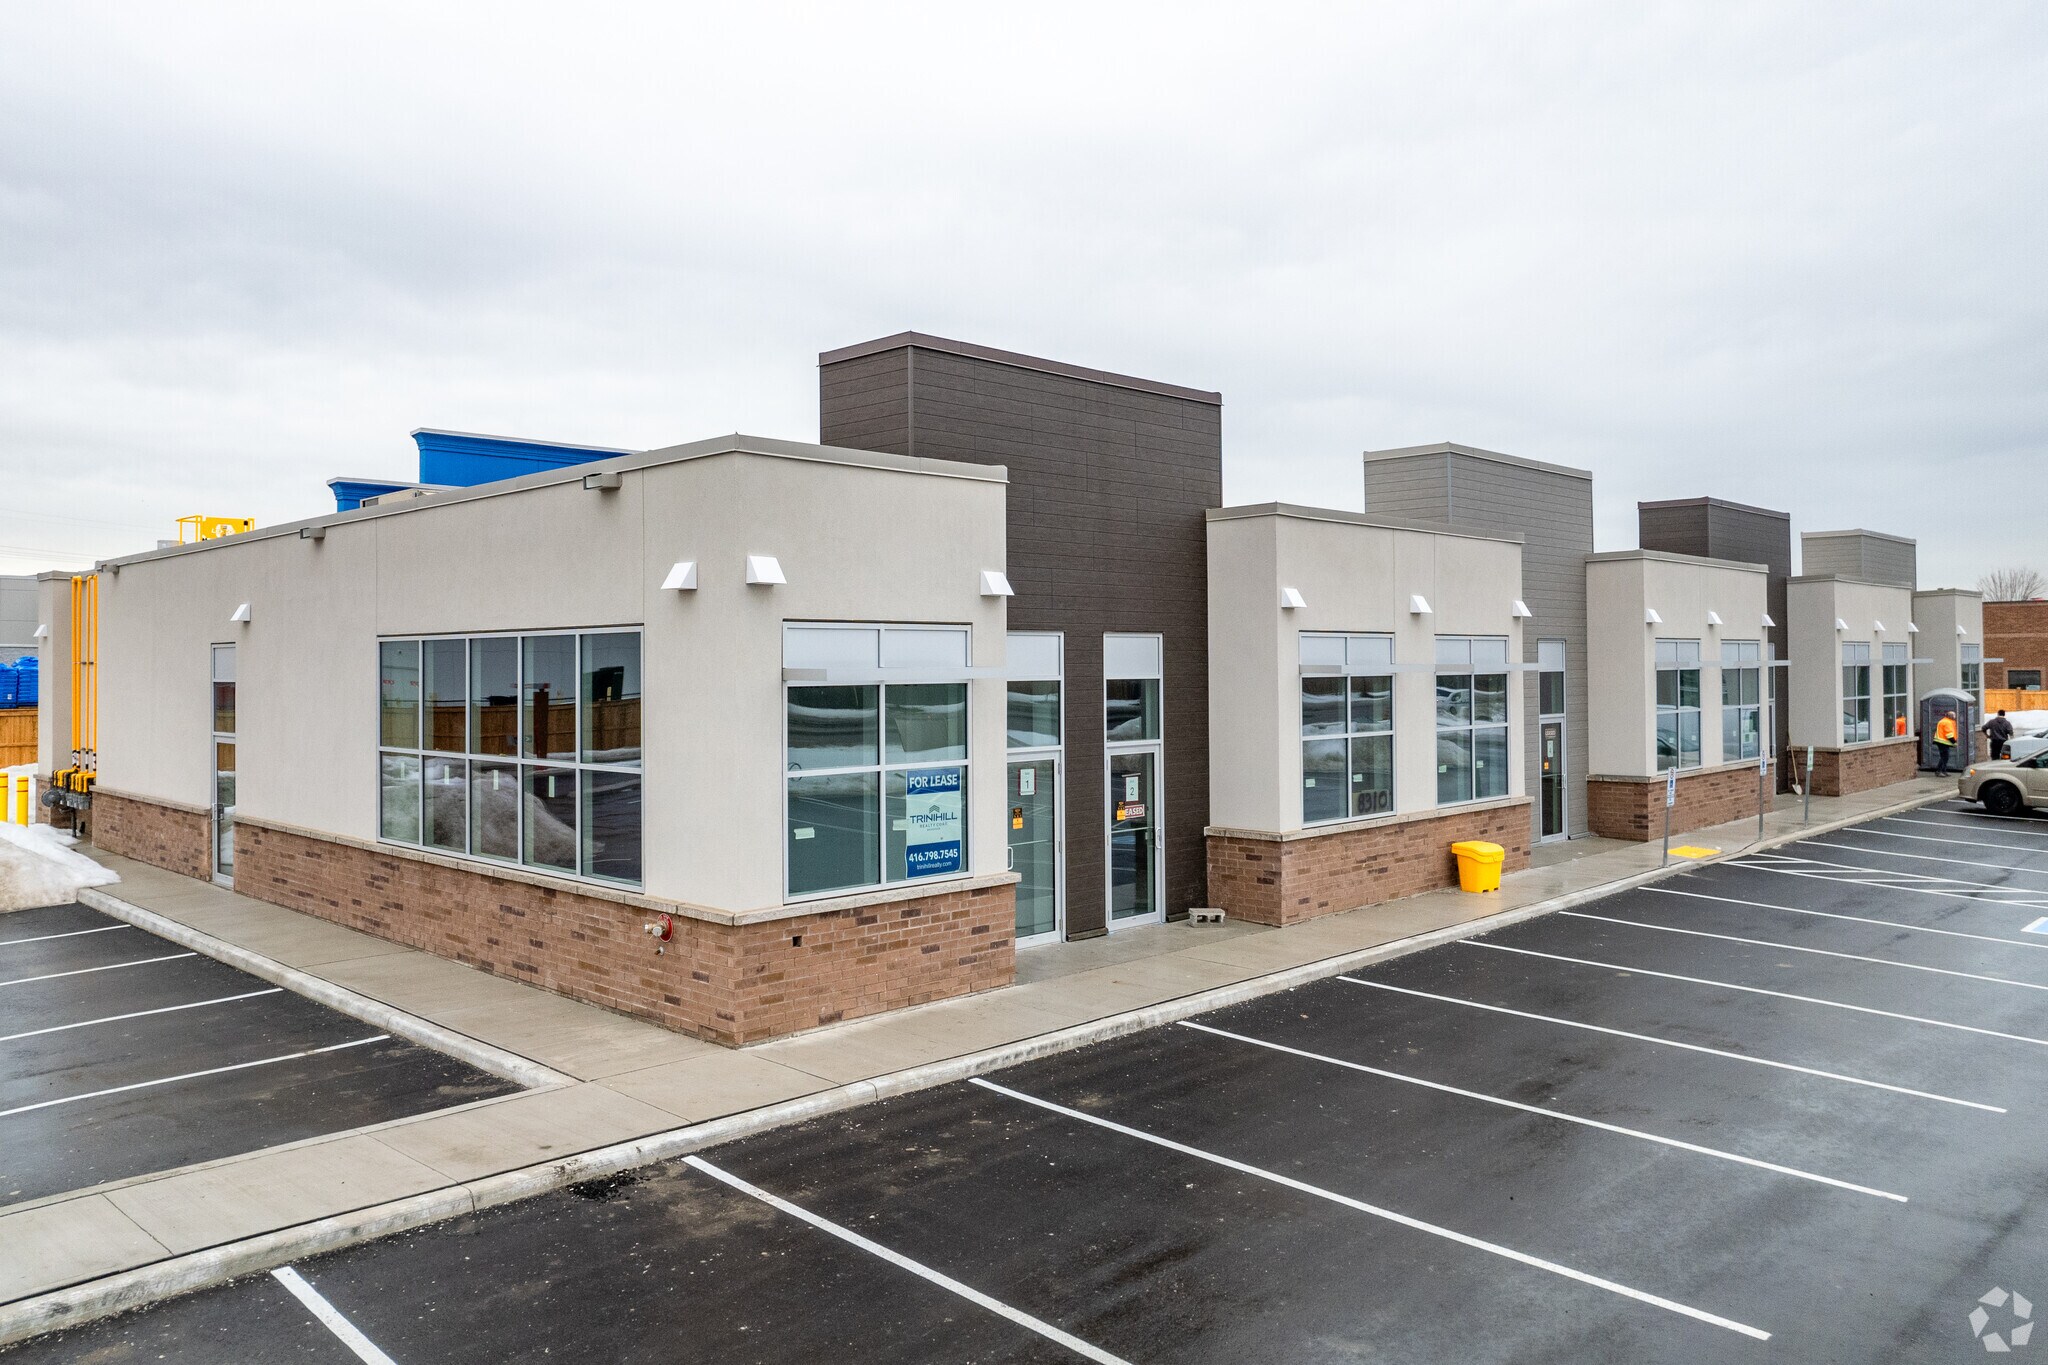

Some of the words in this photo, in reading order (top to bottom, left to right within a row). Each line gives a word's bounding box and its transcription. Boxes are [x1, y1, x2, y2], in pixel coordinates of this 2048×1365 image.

[909, 776, 928, 789] FOR
[930, 774, 957, 787] LEASE
[1130, 787, 1135, 796] 2
[1125, 806, 1143, 816] EASED
[910, 812, 957, 824] TRINIHILL
[909, 848, 958, 863] 416.798.7545
